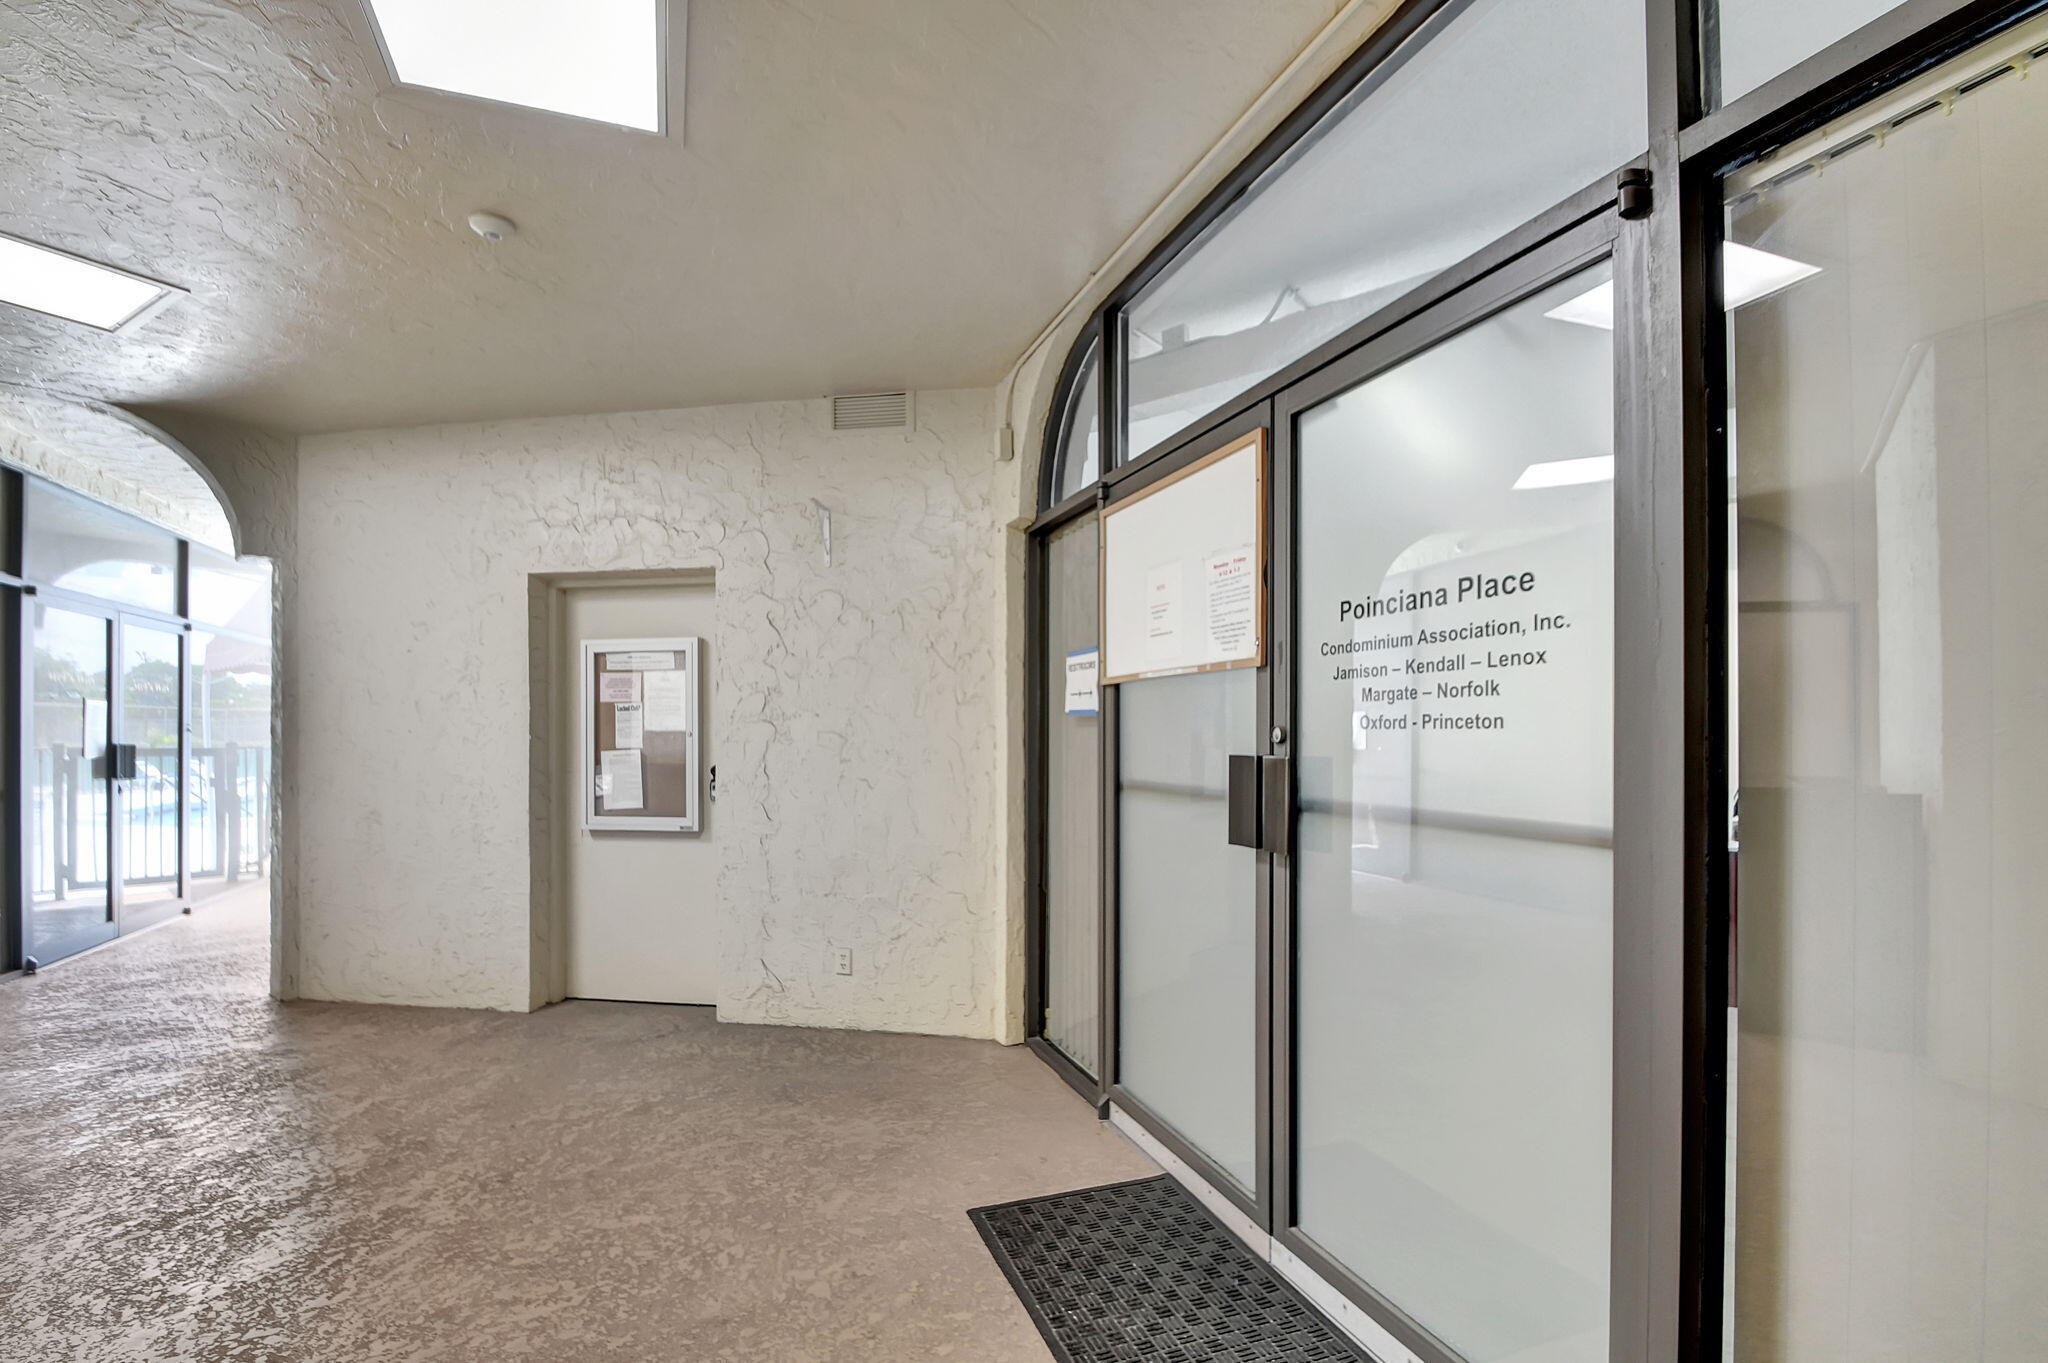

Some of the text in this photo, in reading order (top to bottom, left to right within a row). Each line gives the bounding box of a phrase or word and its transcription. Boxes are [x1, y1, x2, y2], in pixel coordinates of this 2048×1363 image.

[1340, 571, 1536, 622] Poinciana Place
[1320, 613, 1571, 657] Condominium Association, Inc.
[1333, 663, 1388, 681] Jamison
[1405, 654, 1465, 675] Kendall
[1487, 650, 1547, 669] Lenox
[1361, 687, 1418, 705] Margate
[1437, 680, 1501, 699] Norfolk
[1360, 714, 1407, 731] Oxford
[1421, 713, 1505, 730] Princeton
